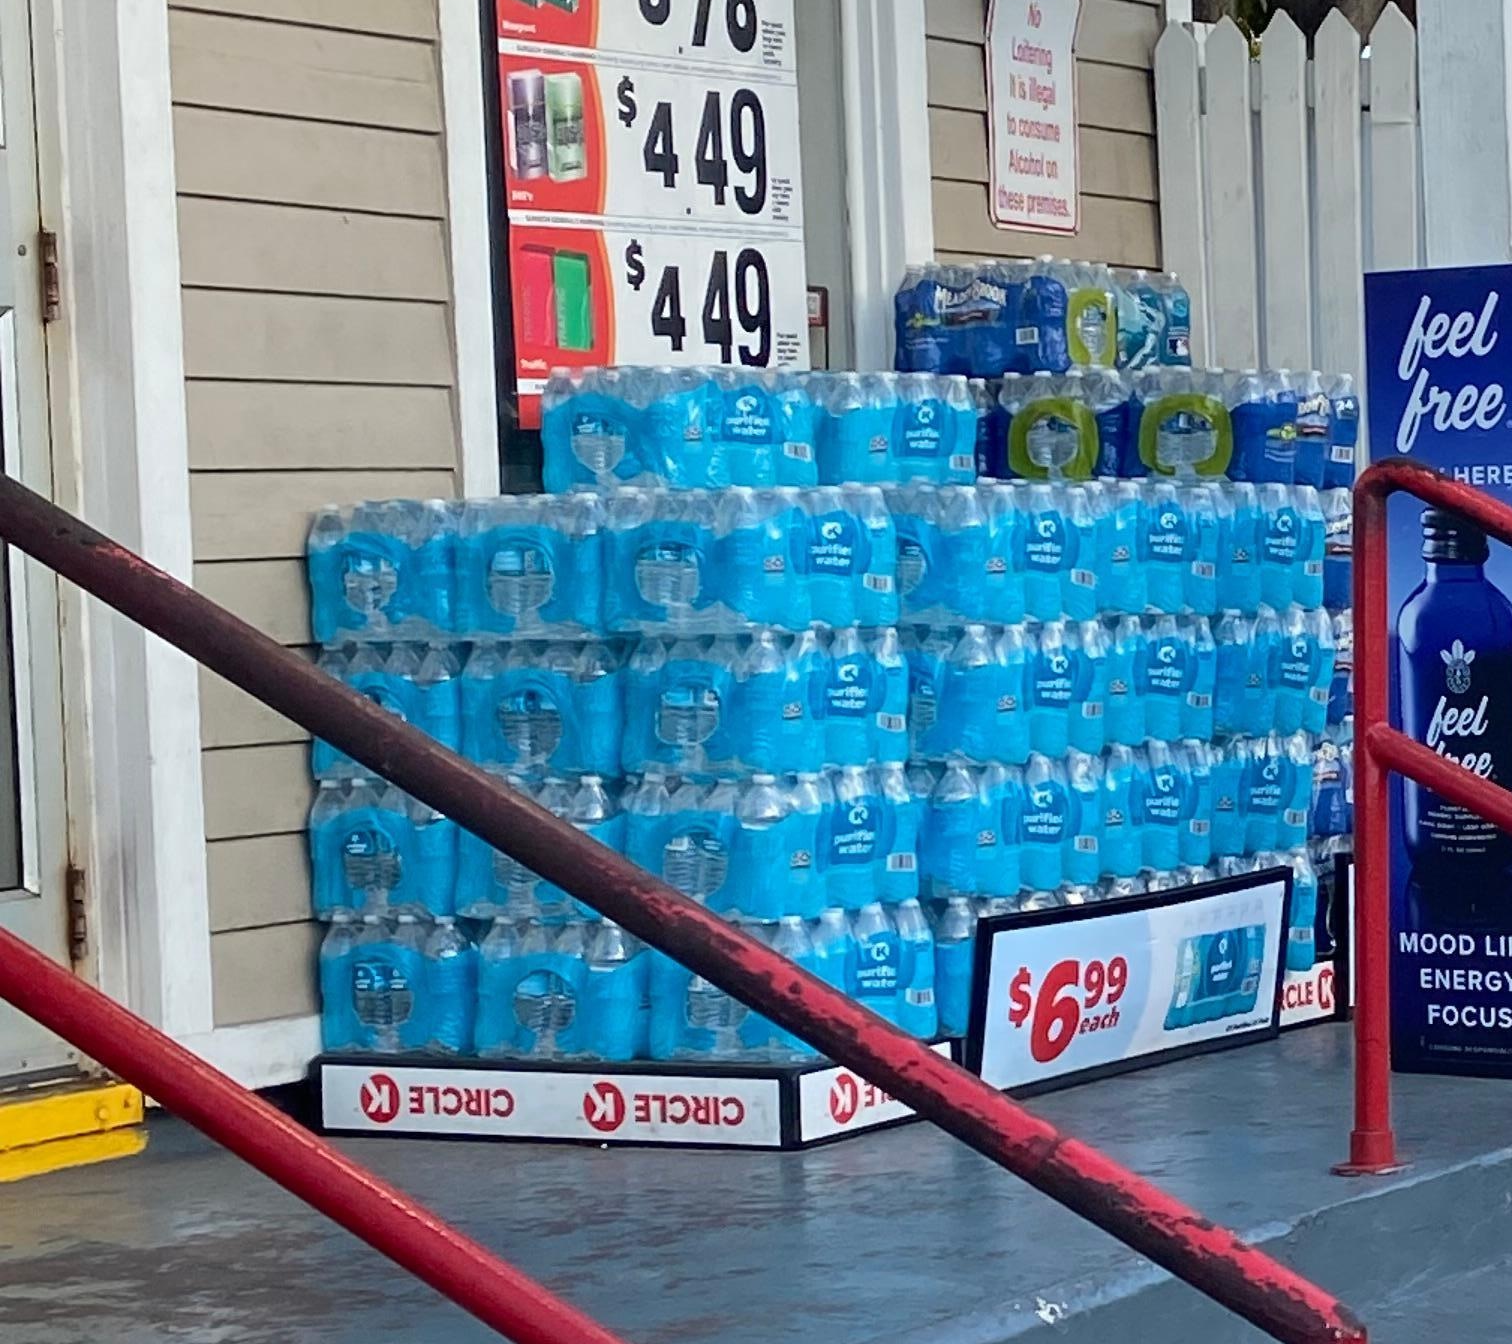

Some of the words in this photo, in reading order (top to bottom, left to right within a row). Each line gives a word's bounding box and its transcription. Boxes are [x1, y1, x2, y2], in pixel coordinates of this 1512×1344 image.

[1027, 2, 1042, 29] No
[1012, 36, 1053, 74] Loitering
[1009, 73, 1016, 99] It
[1018, 79, 1026, 101] is
[1029, 76, 1056, 111] illegal
[1007, 112, 1017, 136] to
[1018, 120, 1060, 143] consume
[1008, 148, 1044, 178] Alcohol
[1046, 159, 1058, 178] on
[998, 184, 1025, 210] these
[1398, 291, 1499, 380] feel
[1396, 368, 1507, 453] free
[1427, 695, 1488, 747] feel
[1399, 932, 1476, 956] MOOD
[1078, 1005, 1121, 1035] each
[1427, 1003, 1512, 1029] FOCUS
[408, 1085, 515, 1117] CIRCLE
[633, 1093, 746, 1127] CIRCLE
